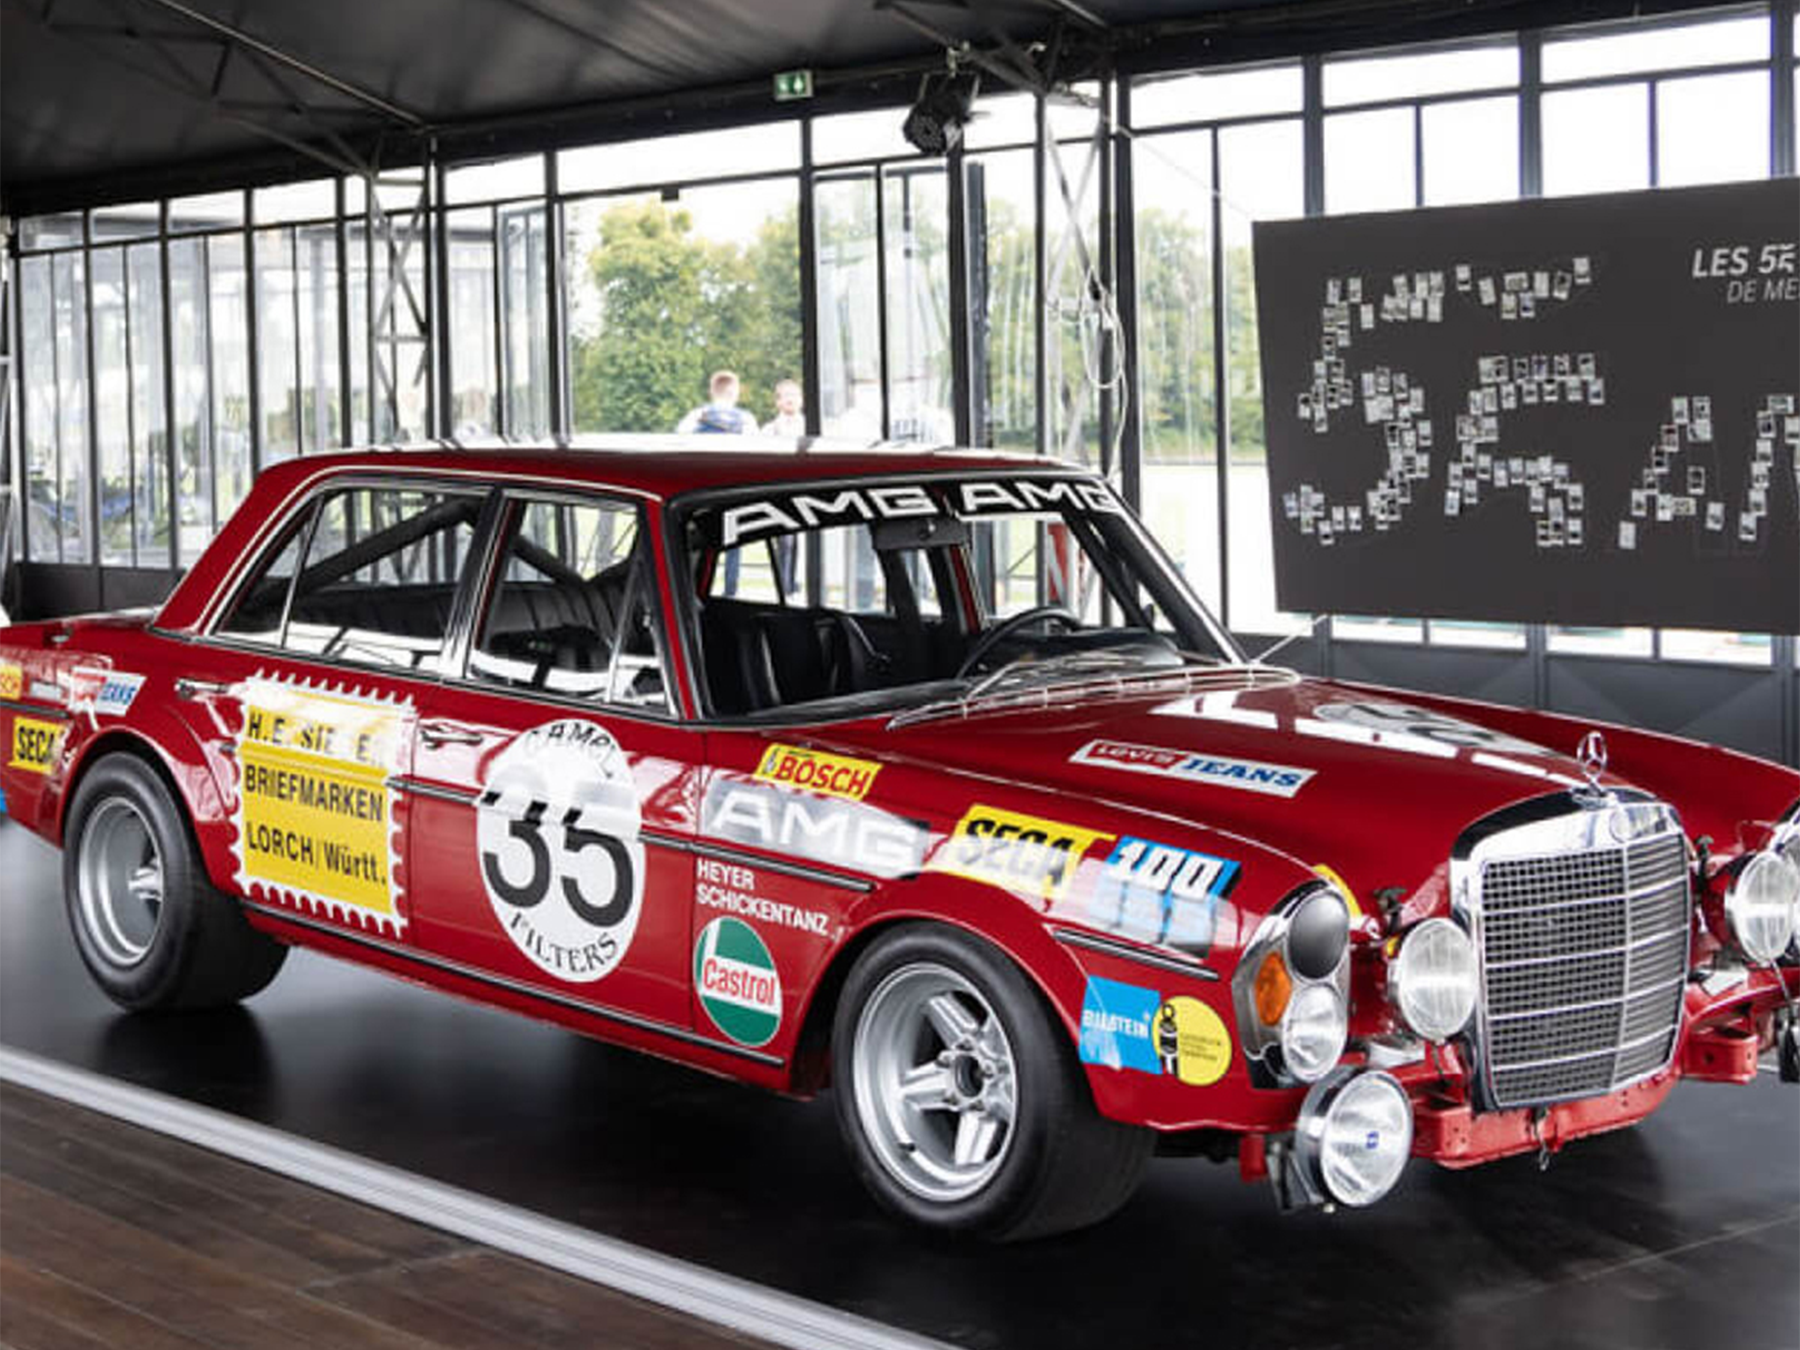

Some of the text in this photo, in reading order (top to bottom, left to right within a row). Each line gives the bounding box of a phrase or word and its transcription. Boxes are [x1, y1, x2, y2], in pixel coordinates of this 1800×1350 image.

[1692, 247, 1749, 278] LES
[1727, 280, 1757, 303] DE
[723, 482, 1123, 546] AMG AMG
[245, 764, 383, 822] BRIEFMARKEN
[777, 755, 870, 796] BOSCH
[1182, 758, 1302, 787] JEANS
[711, 789, 916, 868] AMG
[483, 790, 634, 928] 35
[697, 859, 755, 891] HEYER
[696, 883, 830, 935] SCHICKENTANZ
[510, 912, 618, 973] FILTERS
[703, 957, 776, 1007] Castrol
[1083, 1009, 1149, 1039] BILSTEIN
